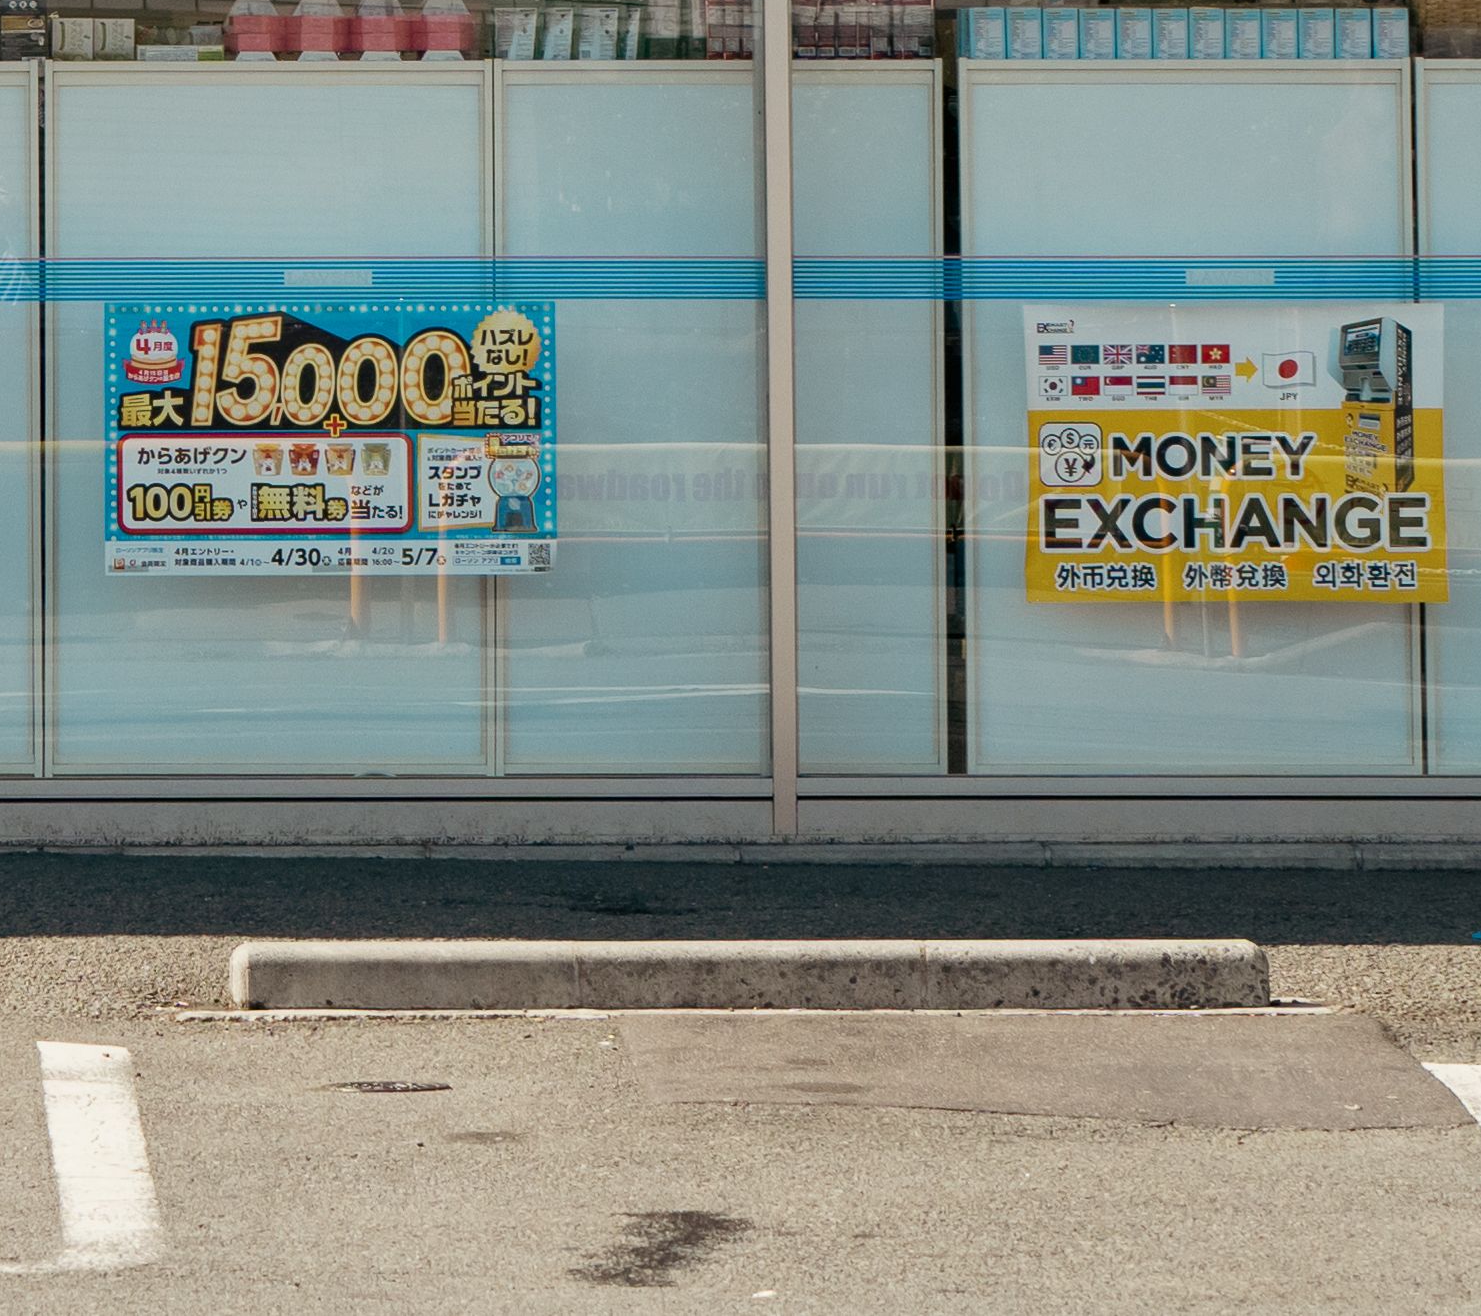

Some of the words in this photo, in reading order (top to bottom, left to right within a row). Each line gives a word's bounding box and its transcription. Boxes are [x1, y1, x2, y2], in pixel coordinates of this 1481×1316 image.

[136, 338, 174, 355] 4月度
[480, 328, 534, 346] ハズレ
[484, 347, 529, 367] なし!
[190, 315, 471, 427] 15,000
[452, 369, 537, 396] ポイント
[1279, 392, 1298, 401] JPY
[120, 389, 185, 427] 最大
[451, 395, 536, 427] 当たる!
[137, 447, 247, 466] からあげクン
[1113, 435, 1314, 477] MONEY
[428, 465, 481, 480] スタンプ
[351, 485, 384, 496] などが
[438, 482, 472, 491] をためて
[257, 483, 349, 521] 無料券
[351, 499, 403, 520] 当たる!
[428, 494, 481, 508] Lガチャ
[1043, 496, 1429, 550] EXCHANGE
[337, 547, 352, 556] 4月
[372, 547, 394, 556] 4/20
[174, 557, 236, 567] 対象商品購入期間
[1056, 564, 1155, 590] 外币兑换
[1183, 564, 1288, 590] 外幣兌換
[1314, 564, 1418, 590] 외화환전
